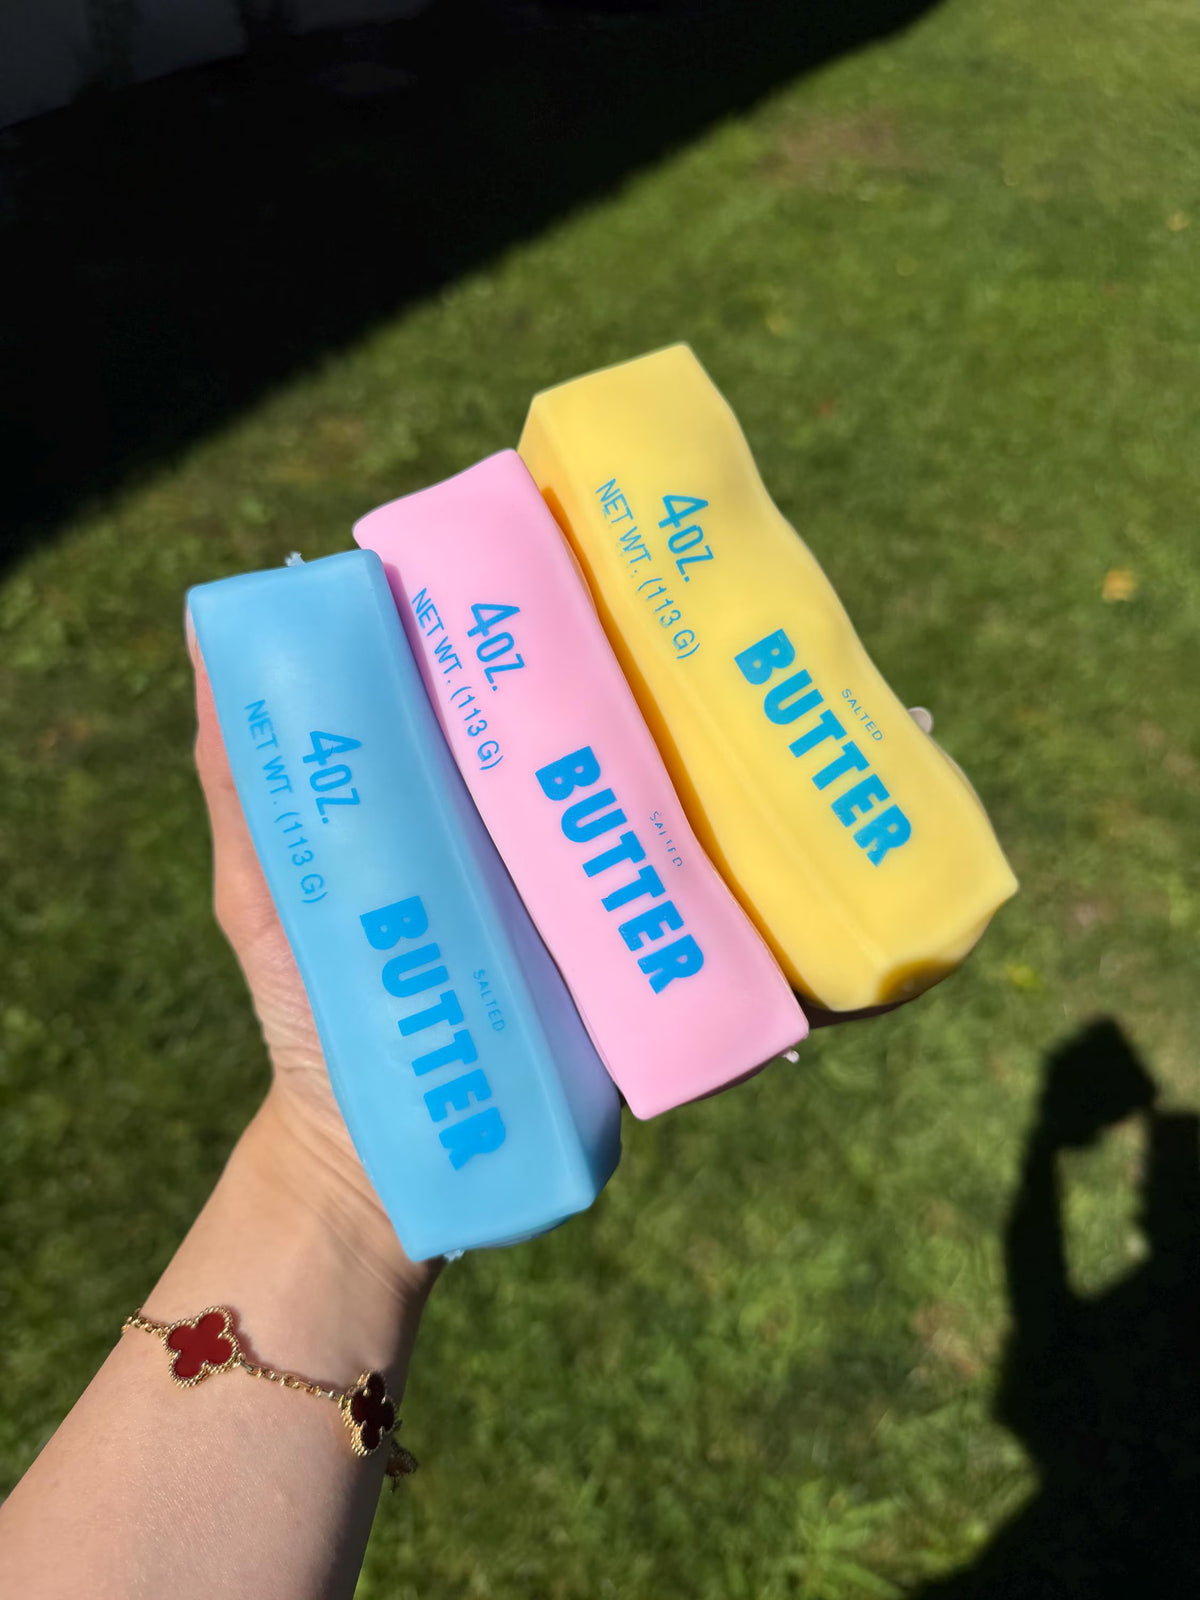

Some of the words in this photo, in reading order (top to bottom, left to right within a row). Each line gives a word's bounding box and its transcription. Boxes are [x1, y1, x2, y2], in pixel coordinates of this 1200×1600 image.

[595, 478, 633, 523] NET
[638, 577, 681, 628] (113
[673, 630, 700, 659] G)
[411, 588, 444, 636] NET
[450, 686, 488, 737] (113
[477, 741, 504, 771] G)
[734, 628, 911, 867] BUTTER
[841, 688, 883, 741] SALTED
[245, 699, 278, 753] NET
[274, 811, 313, 867] (113
[300, 873, 328, 904] G)
[534, 746, 704, 994] BUTTER
[360, 895, 506, 1171] BUTTER
[473, 968, 504, 1032] SALTED
